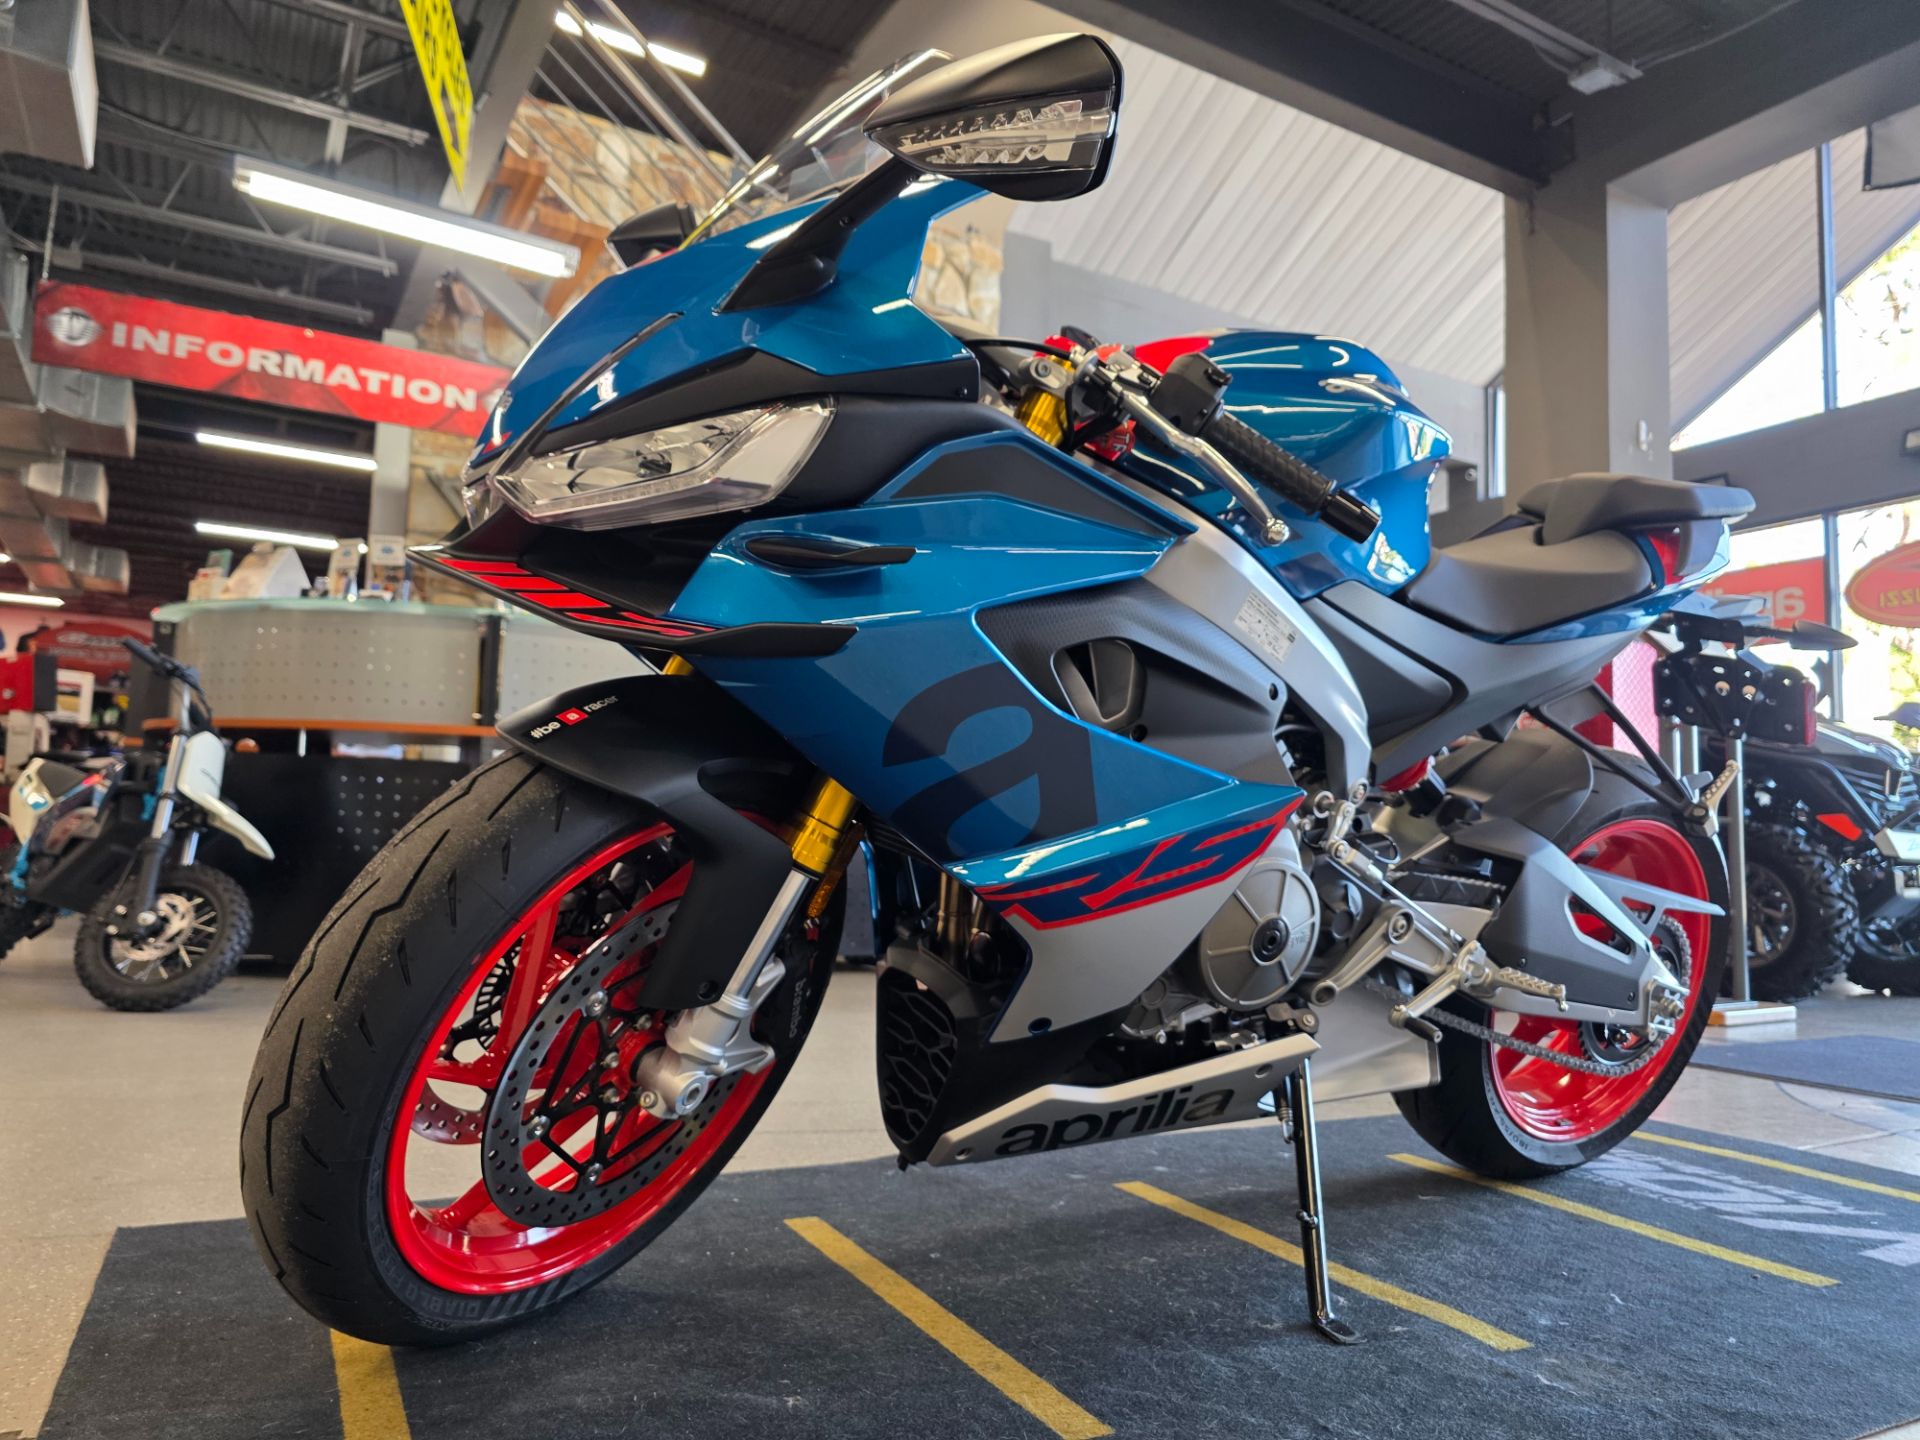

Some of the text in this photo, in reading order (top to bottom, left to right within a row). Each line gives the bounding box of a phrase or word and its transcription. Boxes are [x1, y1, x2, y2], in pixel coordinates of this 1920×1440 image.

[110, 321, 477, 412] INFORMATION
[530, 721, 561, 739] #be
[583, 695, 619, 712] racer
[995, 1085, 1235, 1156] aprilia
